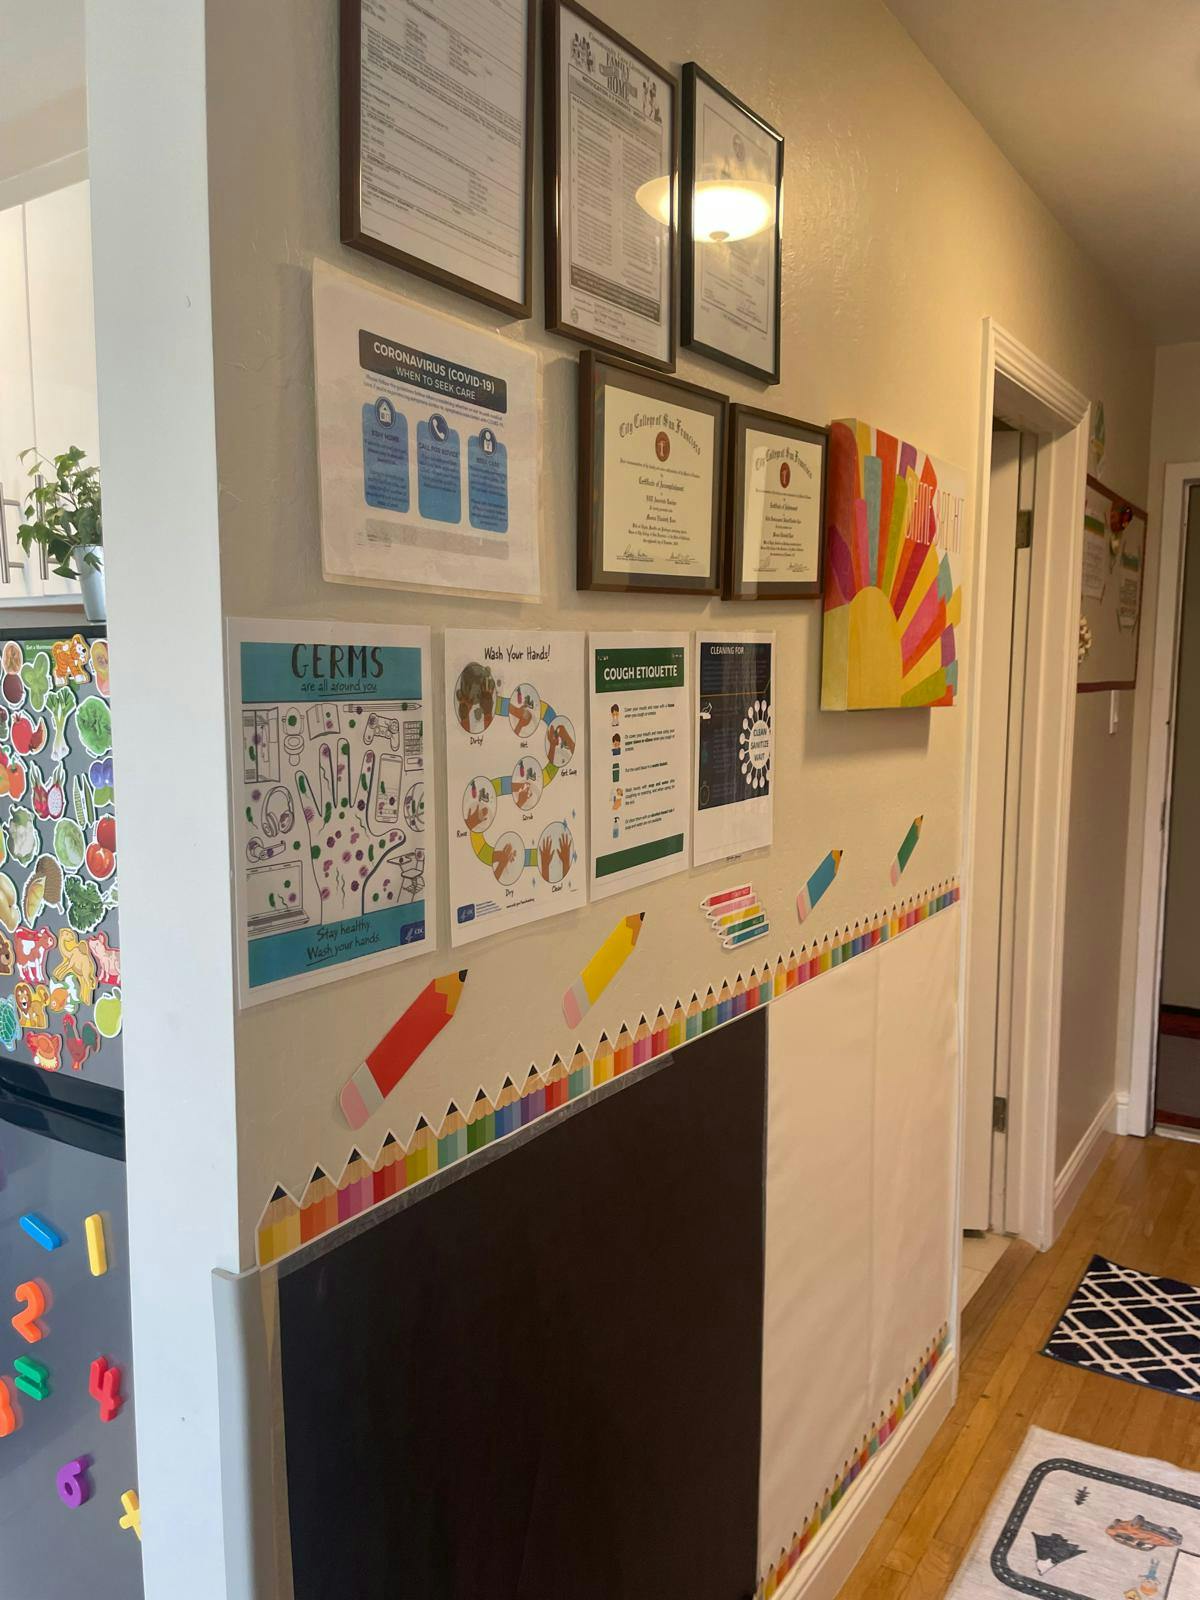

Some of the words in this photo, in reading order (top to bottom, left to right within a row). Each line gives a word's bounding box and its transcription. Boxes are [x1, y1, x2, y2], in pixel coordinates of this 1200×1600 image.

[373, 341, 446, 376] CORONAVIRUS
[448, 367, 495, 394] (COVID-19)
[395, 366, 421, 383] WHEN
[422, 375, 433, 387] TO
[434, 378, 454, 394] SEEK
[455, 386, 476, 400] CARE
[634, 413, 655, 429] College
[484, 646, 504, 660] Wash
[506, 644, 523, 662] Your
[526, 643, 551, 662] Hands!
[710, 646, 735, 655] CLEANING
[735, 646, 745, 655] FOR
[291, 643, 384, 679] GERMS
[604, 666, 635, 681] COUGH
[636, 665, 678, 679] ETIQUETTE
[301, 682, 315, 692] are
[318, 679, 328, 692] all
[331, 679, 360, 692] around
[363, 682, 377, 693] you
[753, 728, 767, 737] CLEAN
[750, 740, 769, 750] SANITIZE
[505, 888, 514, 898] Dry
[316, 926, 337, 941] Stay
[306, 943, 332, 960] Wash
[334, 941, 353, 956] your
[12, 1279, 46, 1344] 2
[89, 1355, 122, 1423] 4
